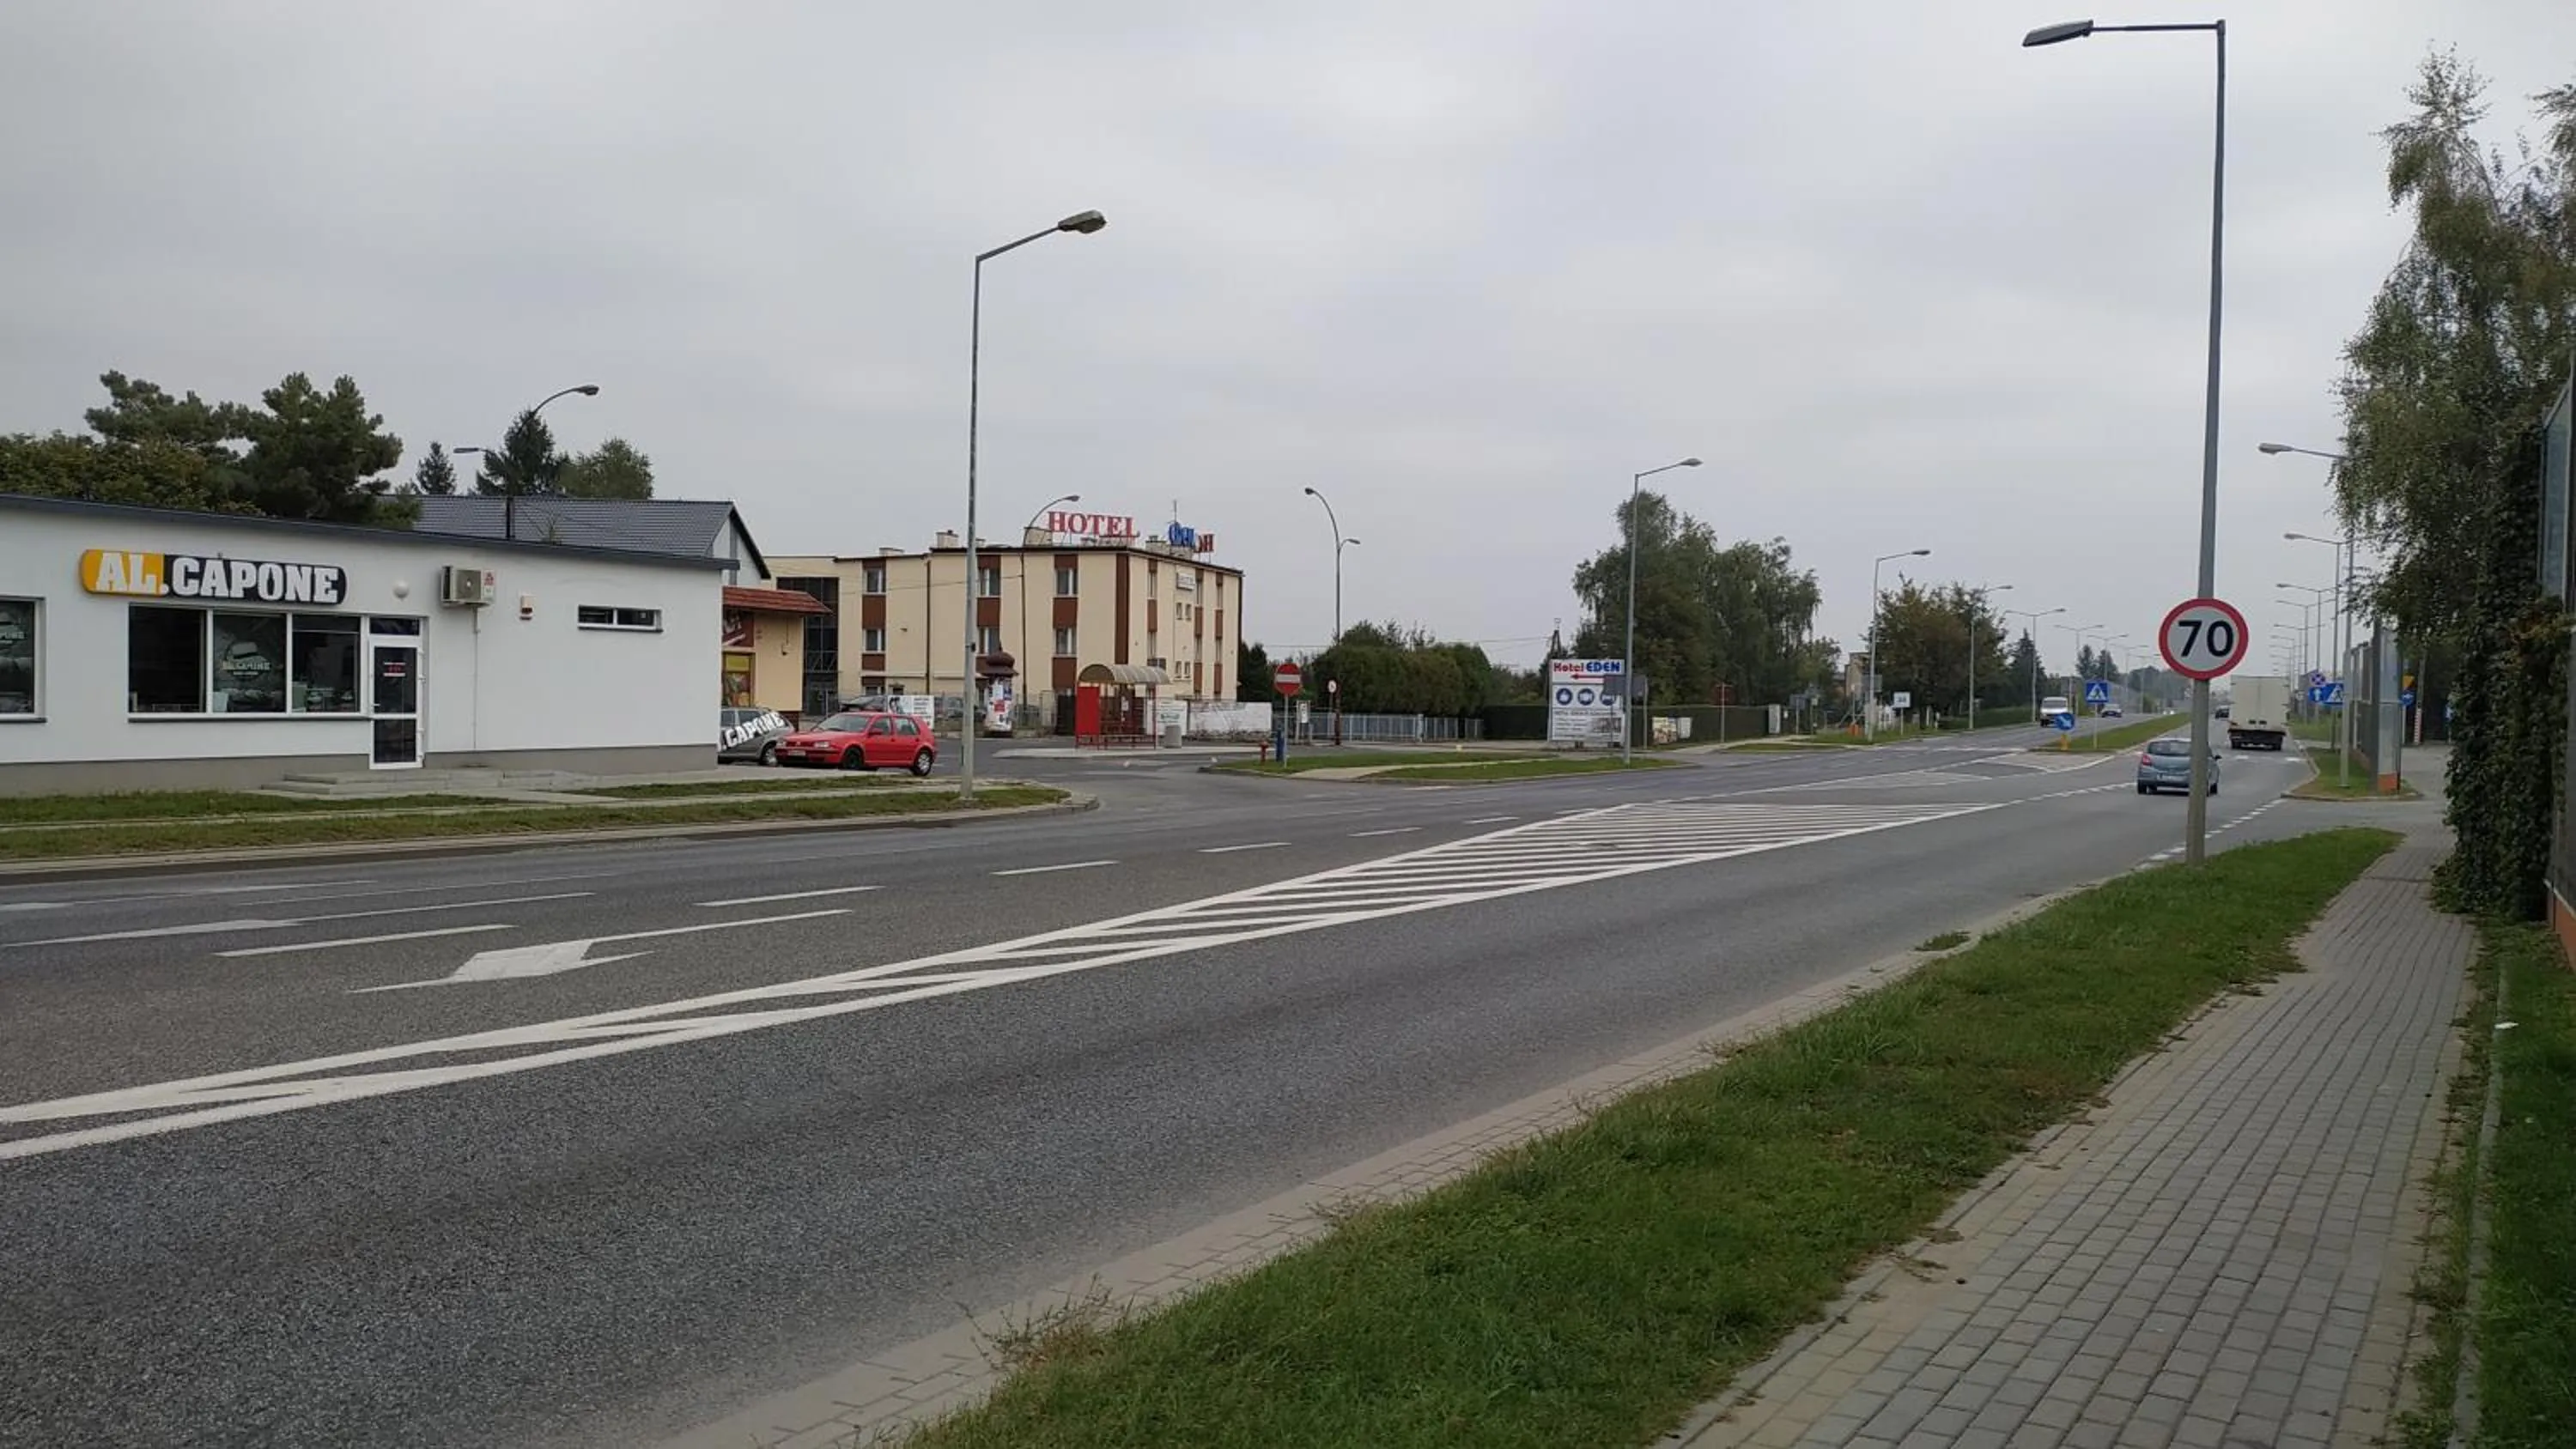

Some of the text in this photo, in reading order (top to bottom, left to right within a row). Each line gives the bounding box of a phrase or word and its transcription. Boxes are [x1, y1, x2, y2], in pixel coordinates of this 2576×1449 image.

[1048, 511, 1140, 538] HOTEL
[2178, 620, 2234, 658] 70
[1553, 661, 1620, 672] Hotel EDEN
